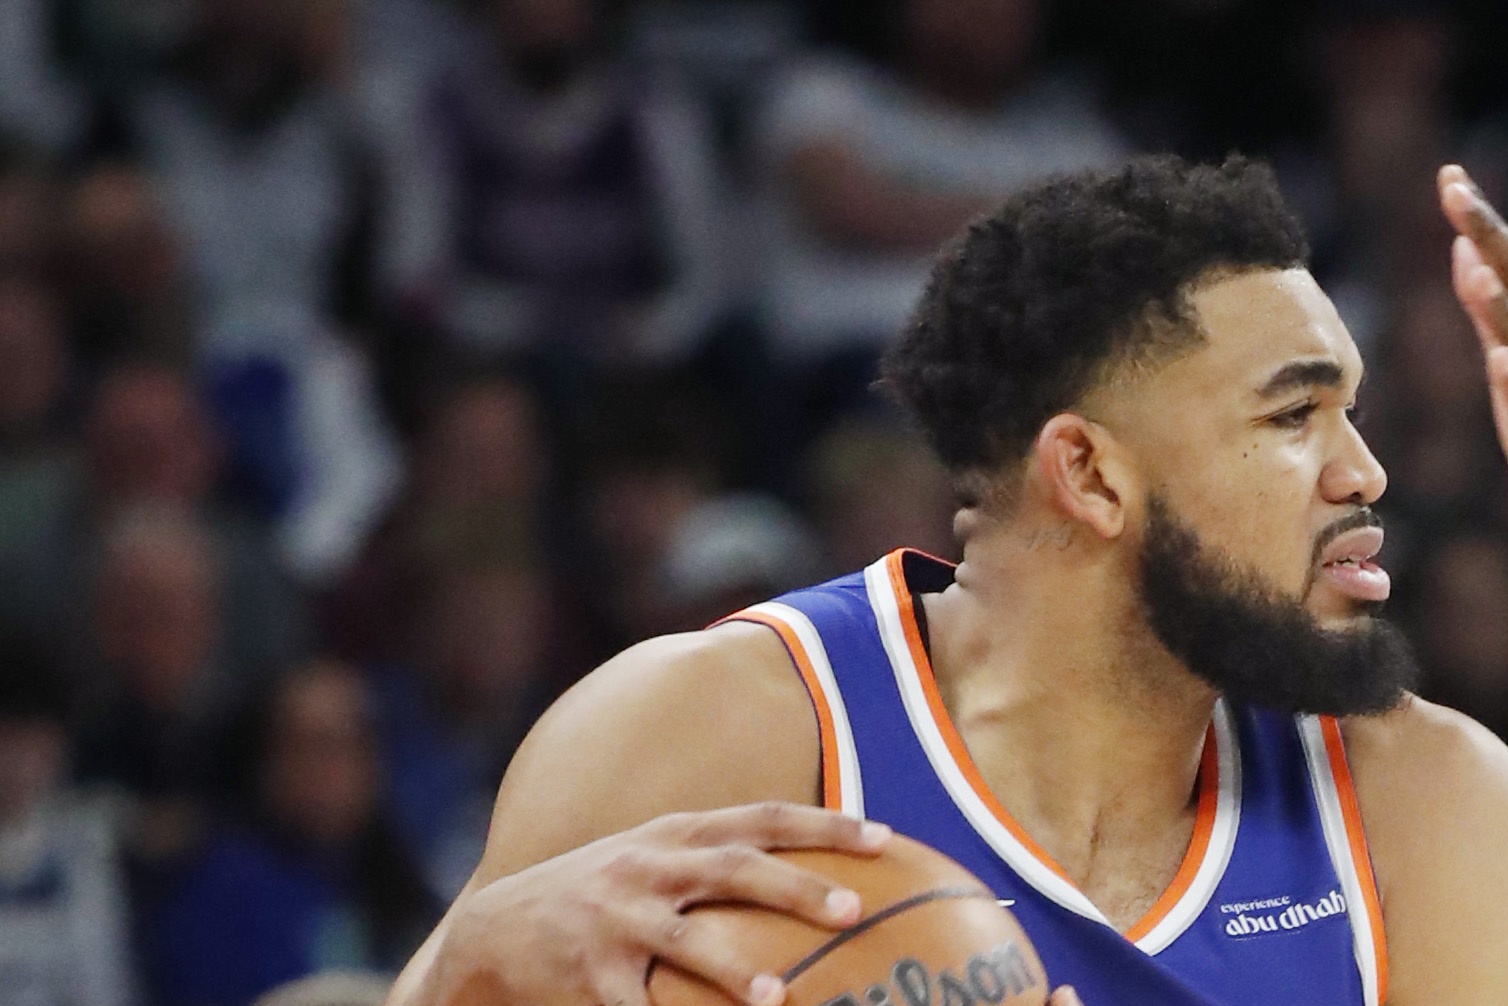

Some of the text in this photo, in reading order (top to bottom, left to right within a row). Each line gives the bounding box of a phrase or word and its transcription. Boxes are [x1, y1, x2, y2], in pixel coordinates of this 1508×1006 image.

[1220, 894, 1291, 914] experience
[1225, 889, 1348, 936] abu dhab
